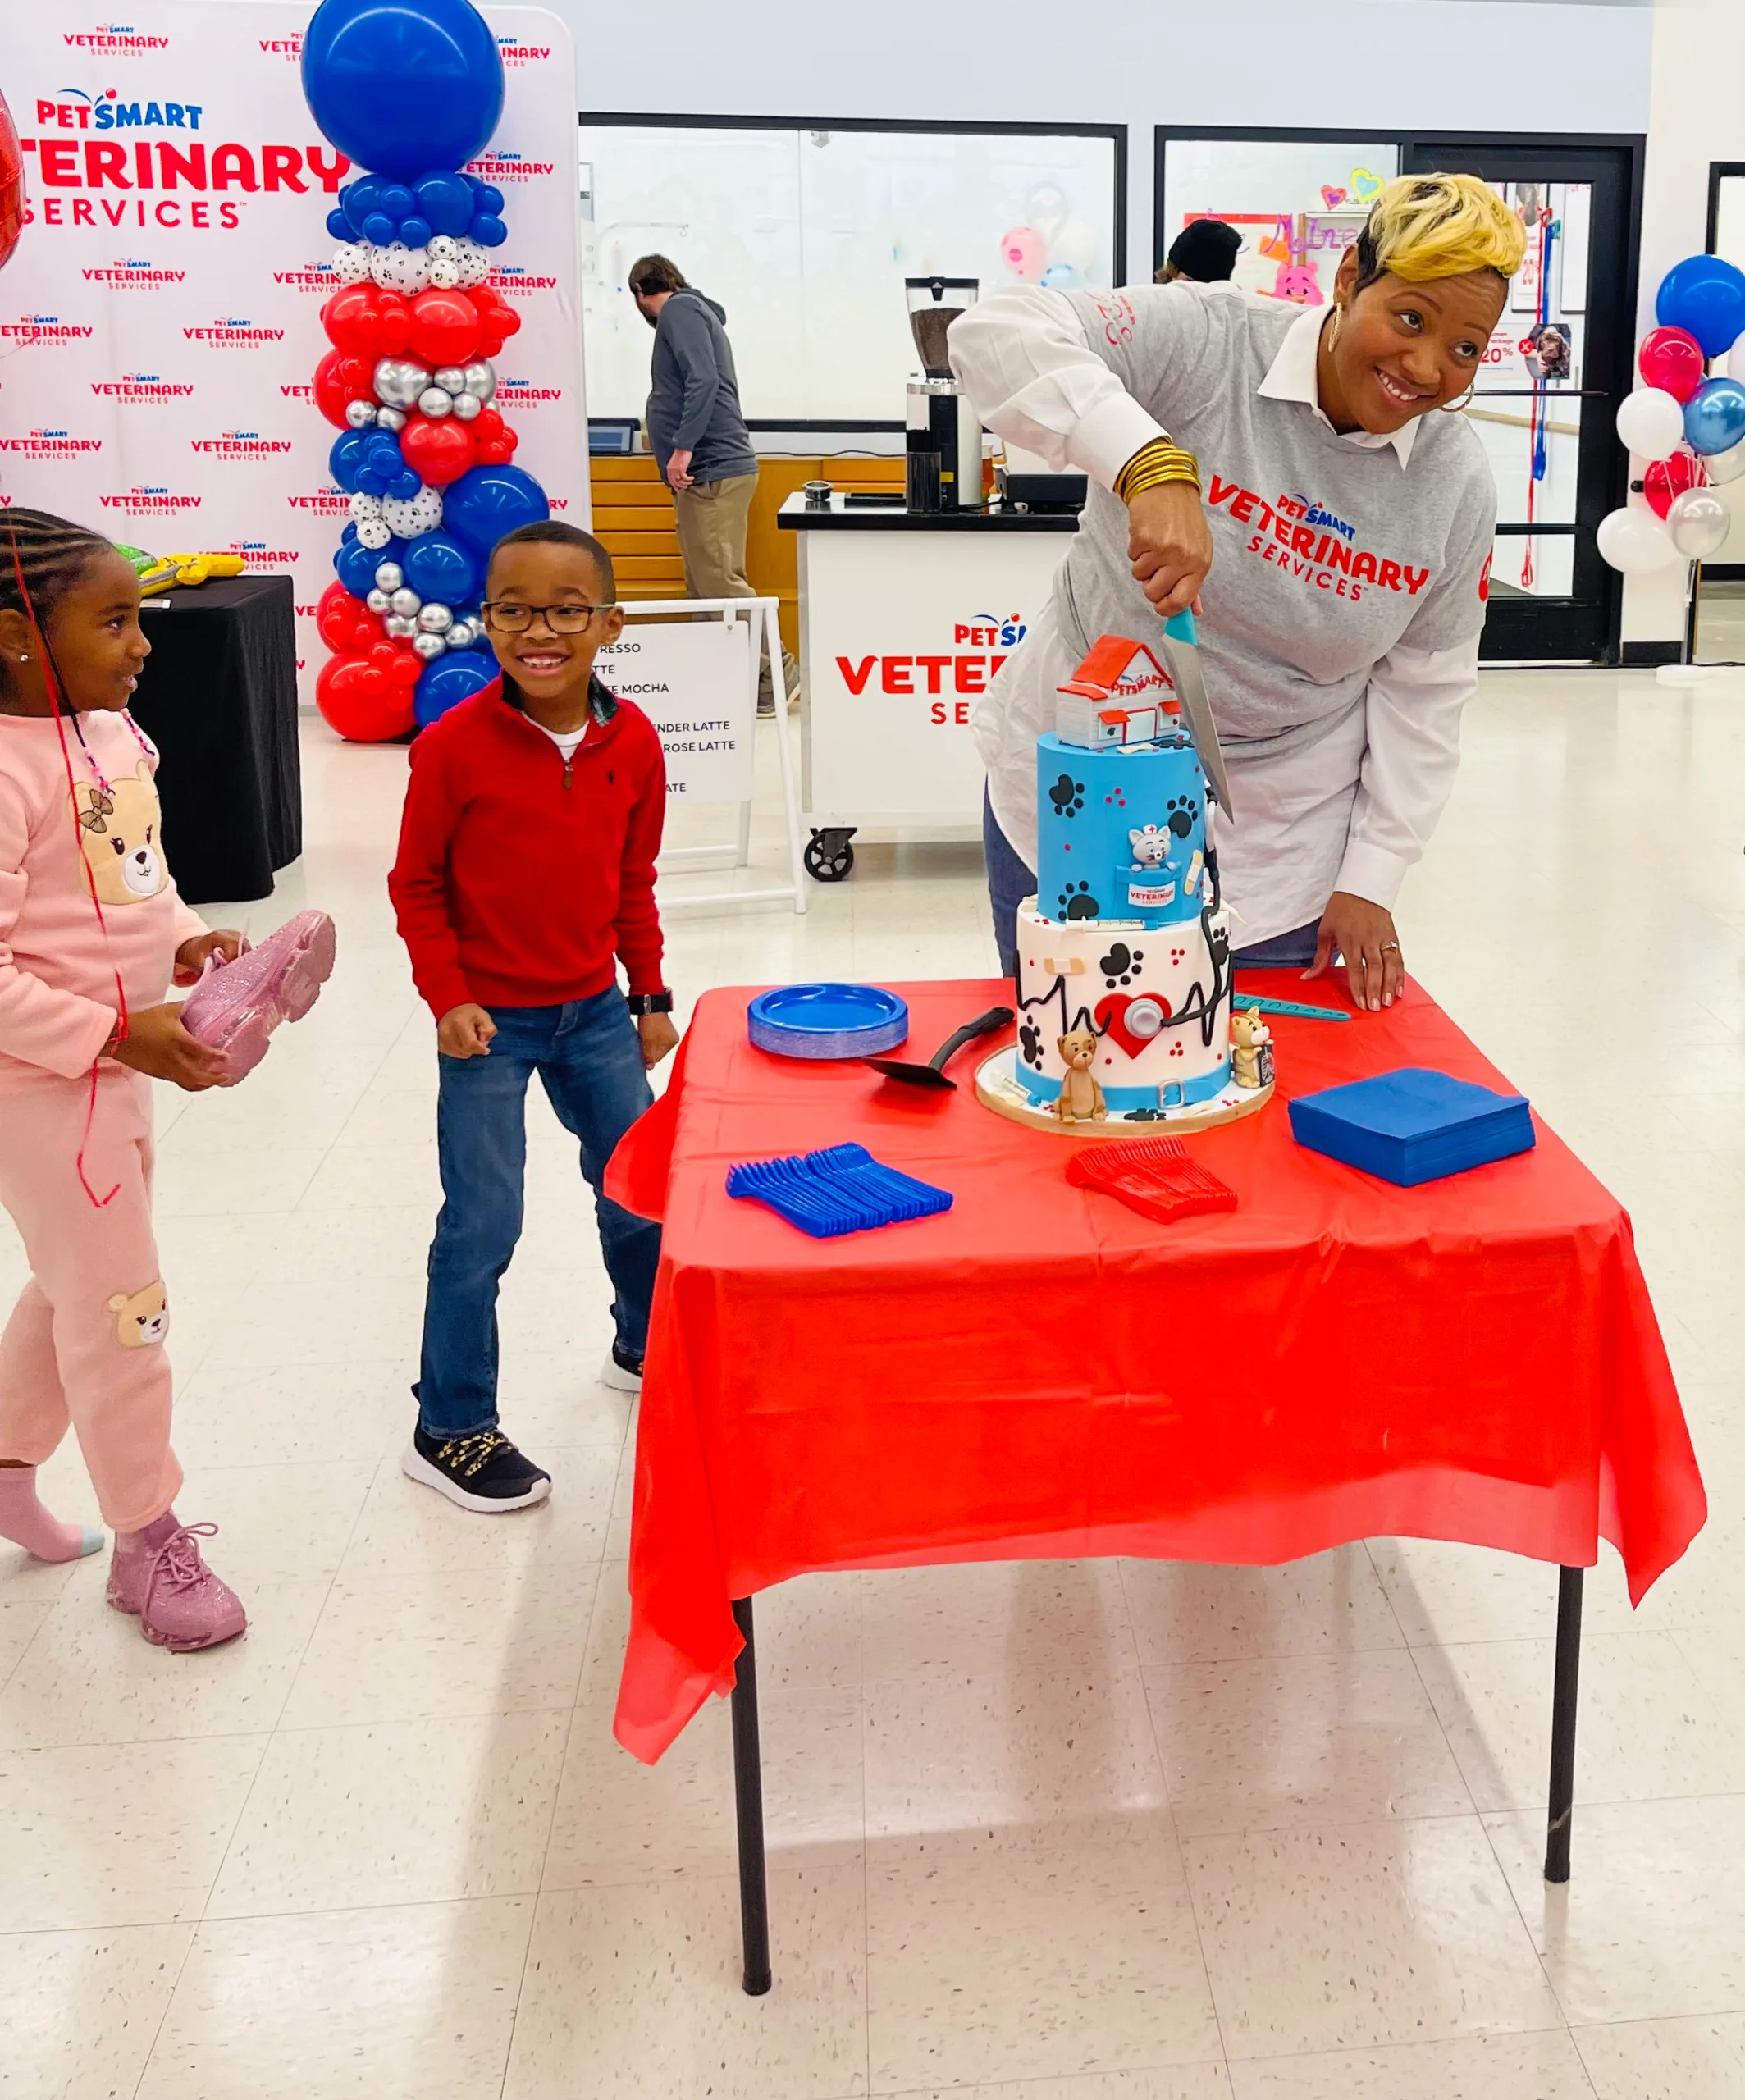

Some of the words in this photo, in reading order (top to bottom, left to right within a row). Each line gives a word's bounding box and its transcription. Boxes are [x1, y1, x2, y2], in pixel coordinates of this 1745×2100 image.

[63, 34, 169, 48] VETERINARY
[465, 162, 554, 174] ETERINARY
[82, 269, 185, 281] VETERINARY
[273, 272, 341, 284] VETERIN
[1, 326, 93, 337] ETERINARY
[183, 328, 284, 340] VETERINARY
[91, 384, 194, 395] VETERINARY
[496, 389, 561, 399] ERINARY
[0, 440, 102, 450] VETERINARY
[191, 441, 291, 452] VETERINARY
[99, 496, 202, 507] VETERINARY
[1208, 475, 1429, 595] VETERINARY
[600, 643, 641, 654] RESSO
[592, 664, 615, 674] TTE
[621, 683, 669, 694] MOCHA
[654, 723, 690, 733] NDER
[692, 721, 730, 731] LATTE
[663, 742, 696, 752] ROSE
[698, 741, 735, 751] LATTE
